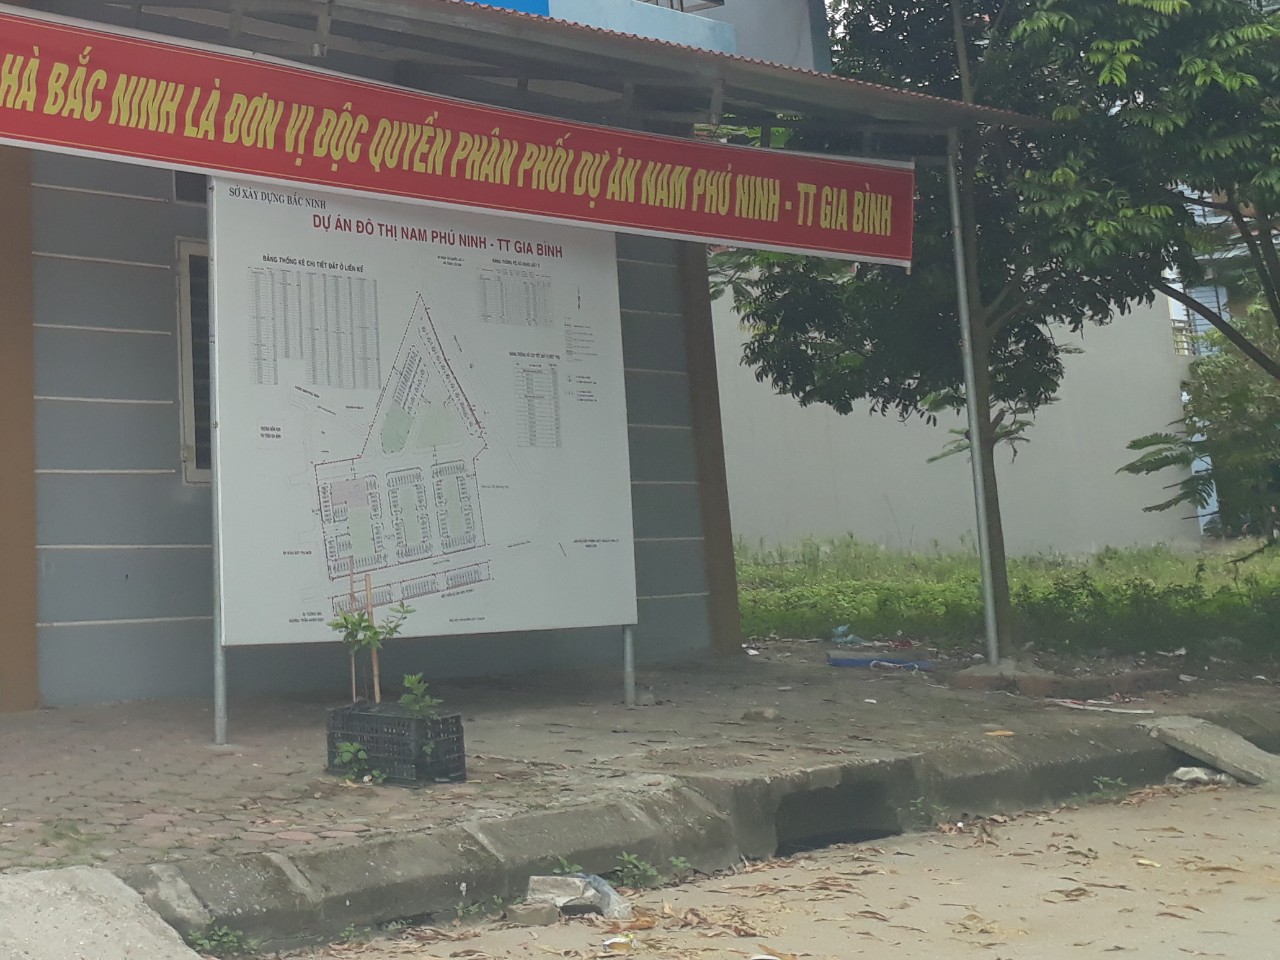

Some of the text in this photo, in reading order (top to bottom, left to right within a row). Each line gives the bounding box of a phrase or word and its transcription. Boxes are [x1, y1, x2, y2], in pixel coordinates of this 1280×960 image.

[43, 45, 107, 122] BẮC
[108, 73, 185, 134] NINH
[184, 77, 221, 141] LÀ
[223, 92, 284, 150] ĐƠN
[285, 103, 314, 166] VỊ
[313, 101, 369, 172] ĐỘC
[369, 110, 455, 176] QUYỀN
[450, 127, 518, 186] PHÂN
[517, 132, 573, 194] PHỐI
[573, 147, 611, 208] DỰ
[606, 147, 641, 203] ÁN
[640, 160, 692, 211] NAM
[691, 162, 733, 216] PHÚ
[735, 174, 781, 222] NINH
[797, 182, 817, 227] TT
[819, 185, 848, 232] GIA
[852, 182, 892, 237] BÌNH
[229, 184, 327, 210] SỞ XÂY DỰNG BẮC NINH
[313, 213, 563, 259] DỰ ÁN ĐÔ THỊ NAM PHÚ NINH TT GIA BÌNH
